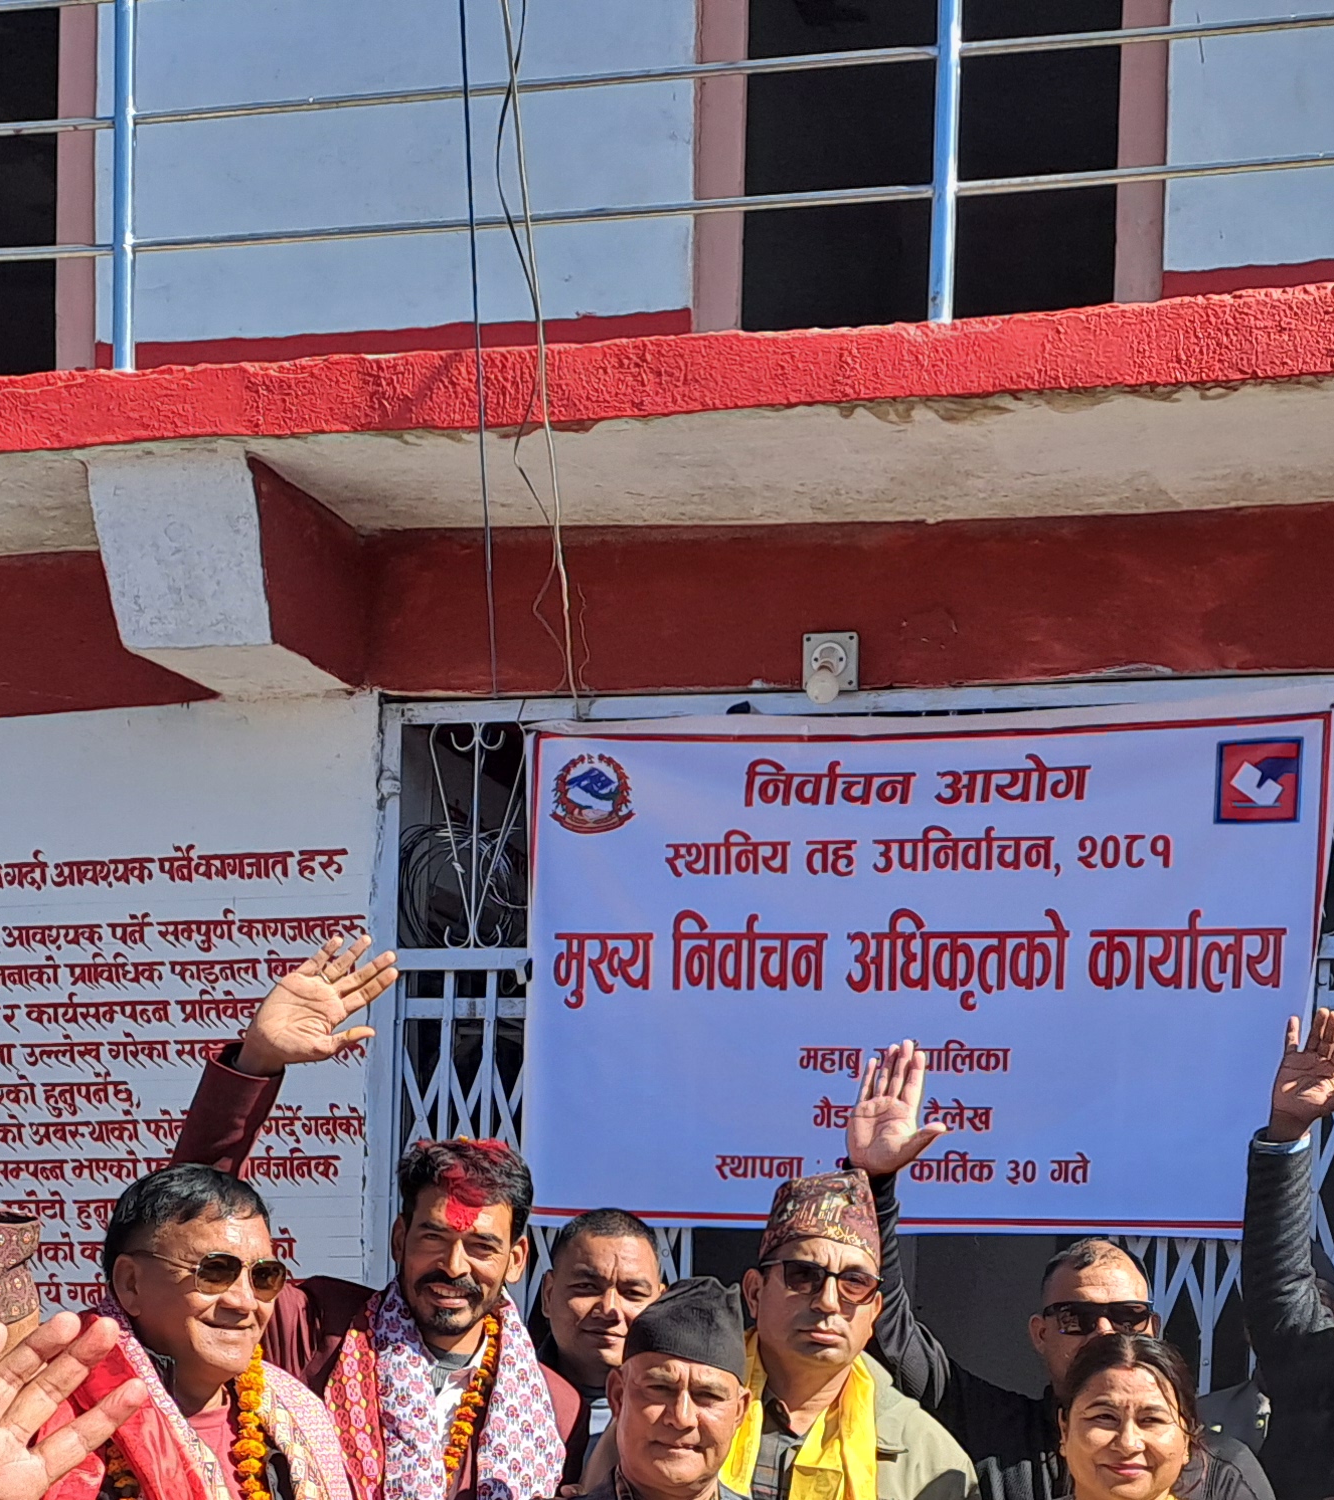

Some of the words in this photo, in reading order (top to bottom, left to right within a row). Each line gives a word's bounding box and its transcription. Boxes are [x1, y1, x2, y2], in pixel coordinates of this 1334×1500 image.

[744, 757, 917, 808] निर्वाचन
[934, 753, 1091, 805] आयोग
[664, 829, 791, 878] स्थानिय
[805, 839, 857, 877] तह
[872, 825, 1061, 877] उपनिर्वाचन,
[1077, 833, 1172, 869] २०८१
[107, 912, 154, 951] पर्ने
[553, 932, 654, 1010] मुख्य
[672, 909, 828, 991] निर्वाचन
[846, 908, 1070, 1011] अधिकृतको
[1088, 908, 1288, 994] कार्यालय
[3, 1004, 21, 1034] र
[799, 1045, 861, 1079] महाबु
[715, 1154, 804, 1181] स्थापना
[909, 1149, 996, 1183] कार्तिक
[1006, 1158, 1036, 1185] ३०
[1050, 1152, 1091, 1185] गते
